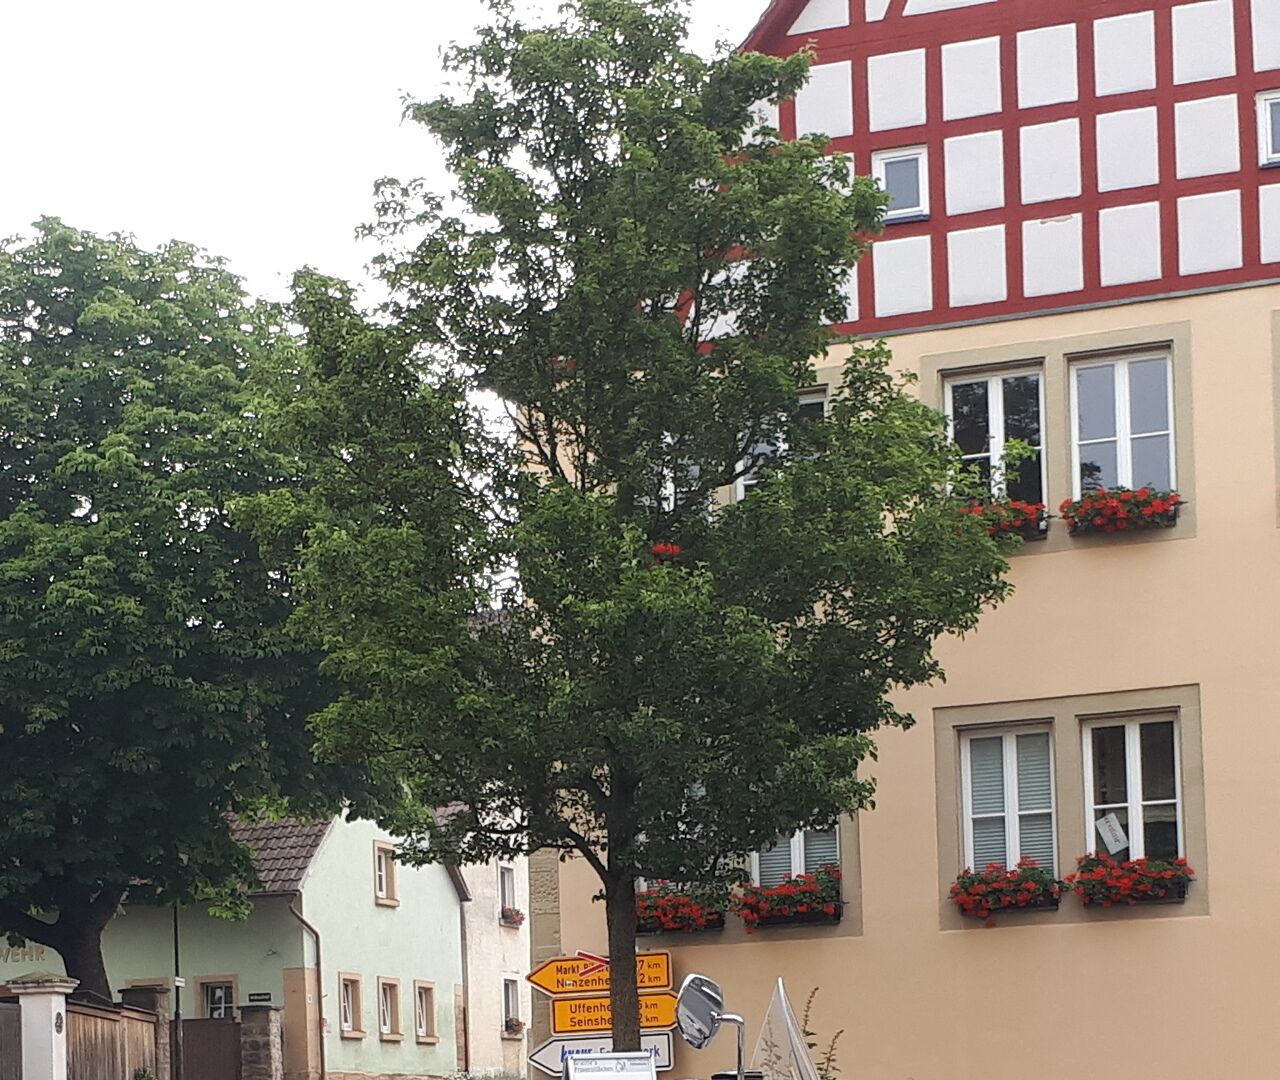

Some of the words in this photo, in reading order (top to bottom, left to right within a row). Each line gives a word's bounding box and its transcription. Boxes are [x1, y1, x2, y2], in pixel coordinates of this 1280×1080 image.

[556, 963, 580, 975] Markt
[556, 978, 611, 988] Nnzenhe
[639, 973, 646, 984] 2
[570, 1002, 612, 1014] Uffenhe
[570, 1016, 612, 1026] Seinshe
